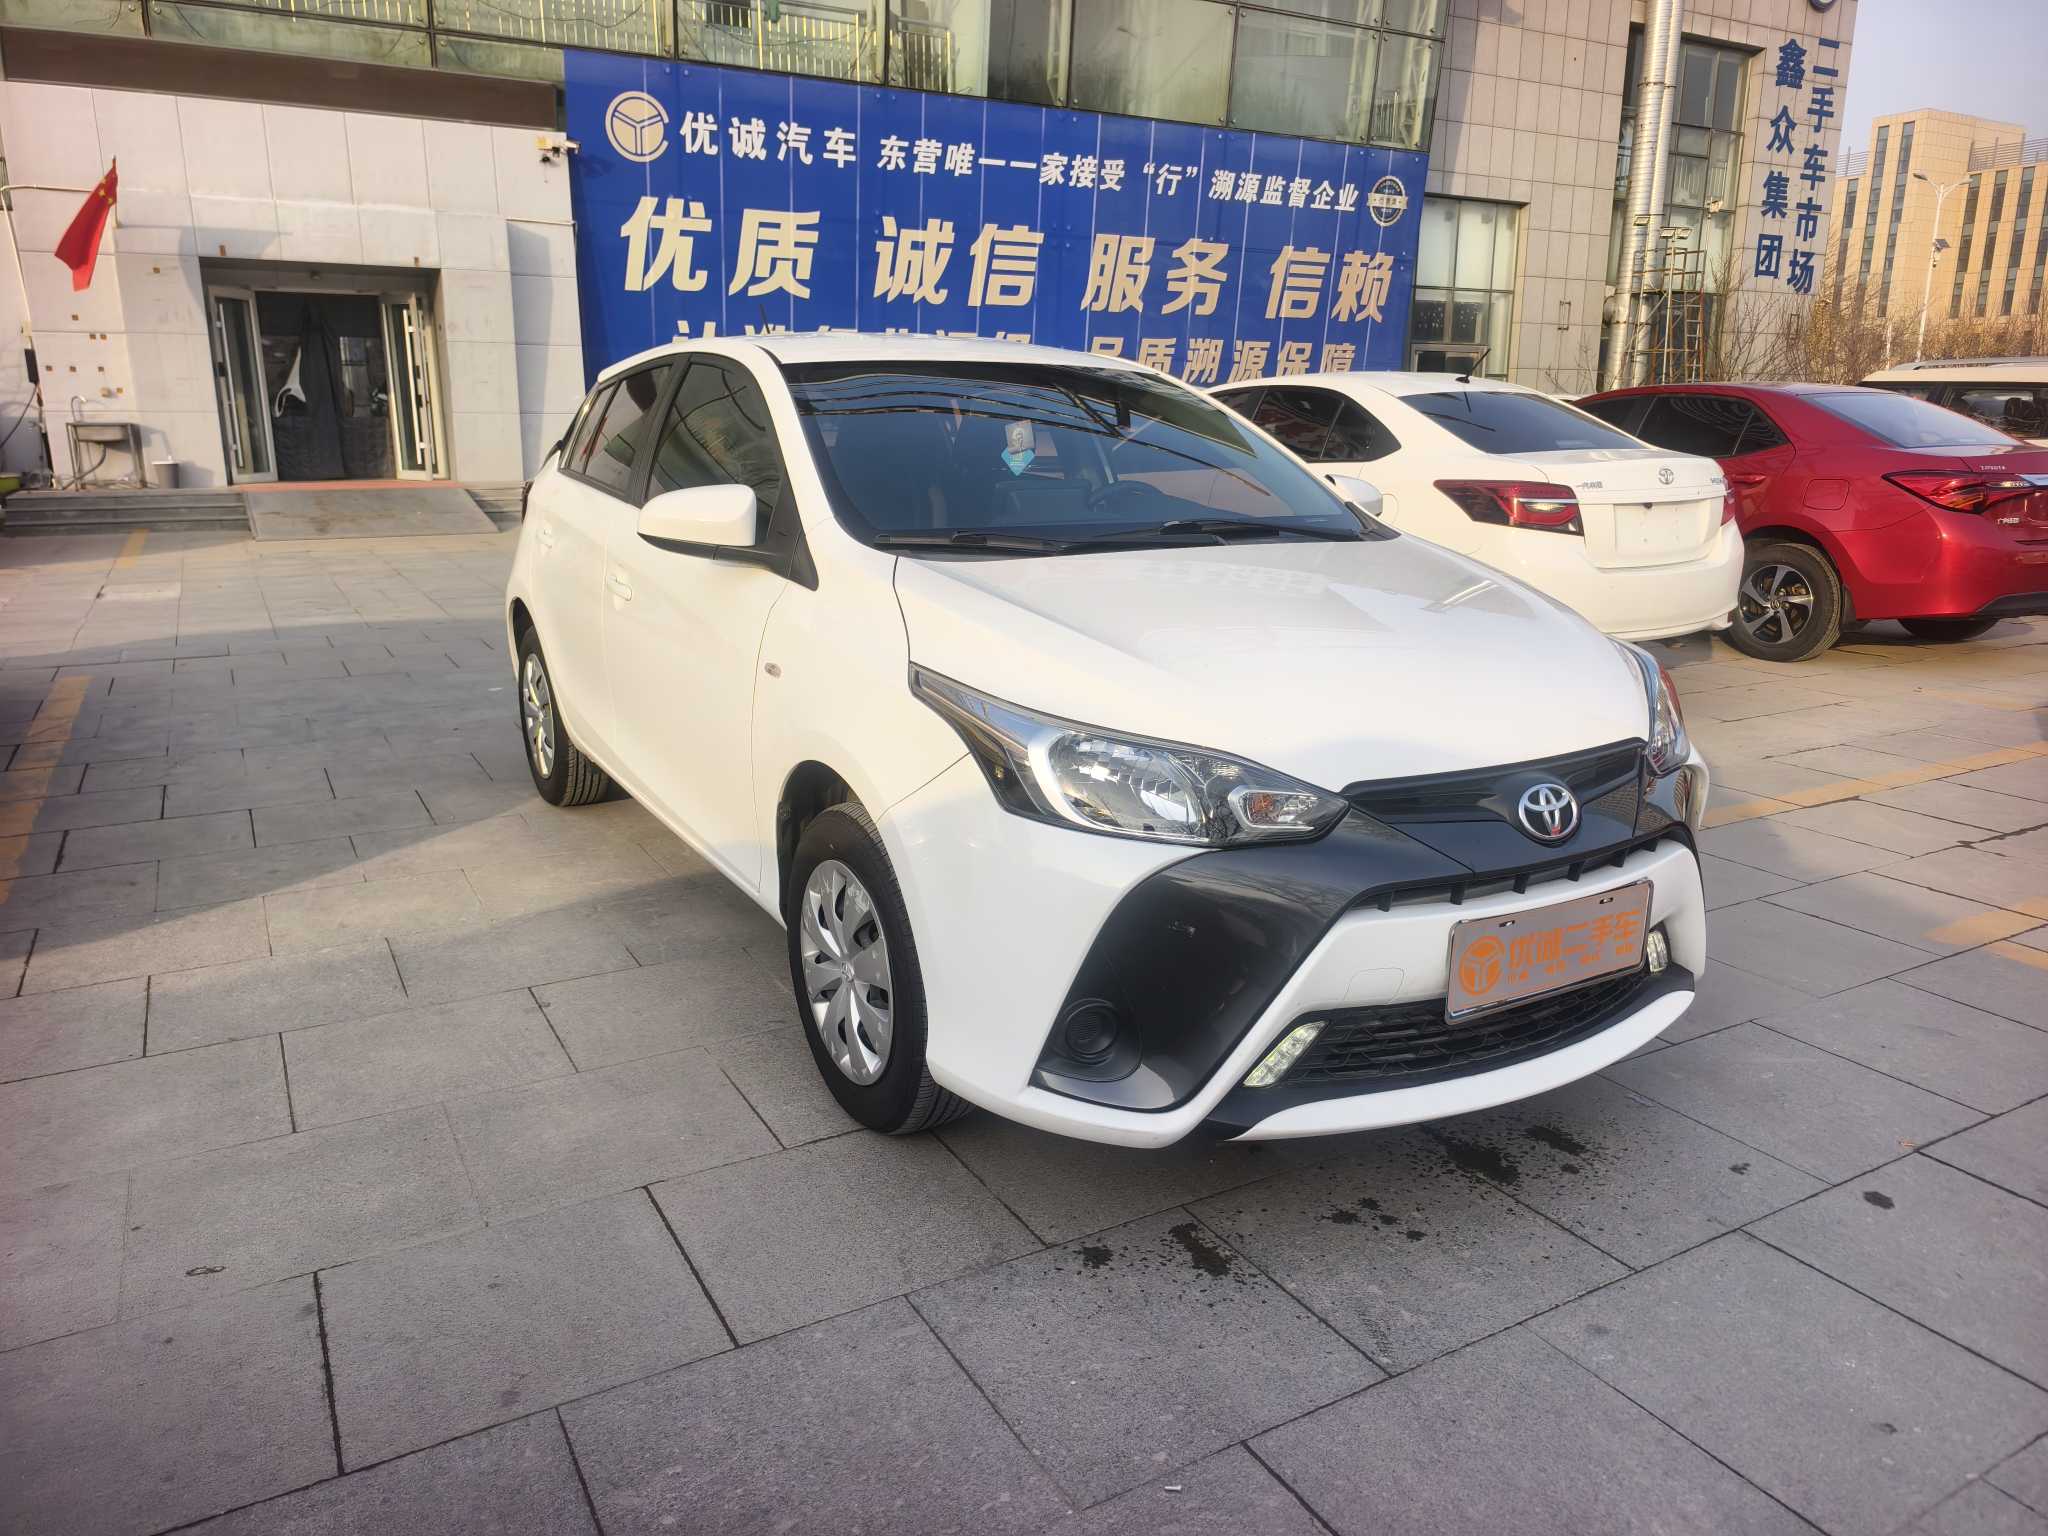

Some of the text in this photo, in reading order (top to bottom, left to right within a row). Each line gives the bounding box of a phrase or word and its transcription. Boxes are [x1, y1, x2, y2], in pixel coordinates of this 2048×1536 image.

[680, 111, 857, 169] 优诚汽车
[877, 135, 1125, 191] 东营唯一一家接受
[1208, 169, 1359, 212] 溯源监督企业
[1754, 38, 1807, 279] 鑫众集团
[1787, 37, 1840, 294] 二手车市场
[620, 196, 1394, 323] 优质 诚信 服务 信赖
